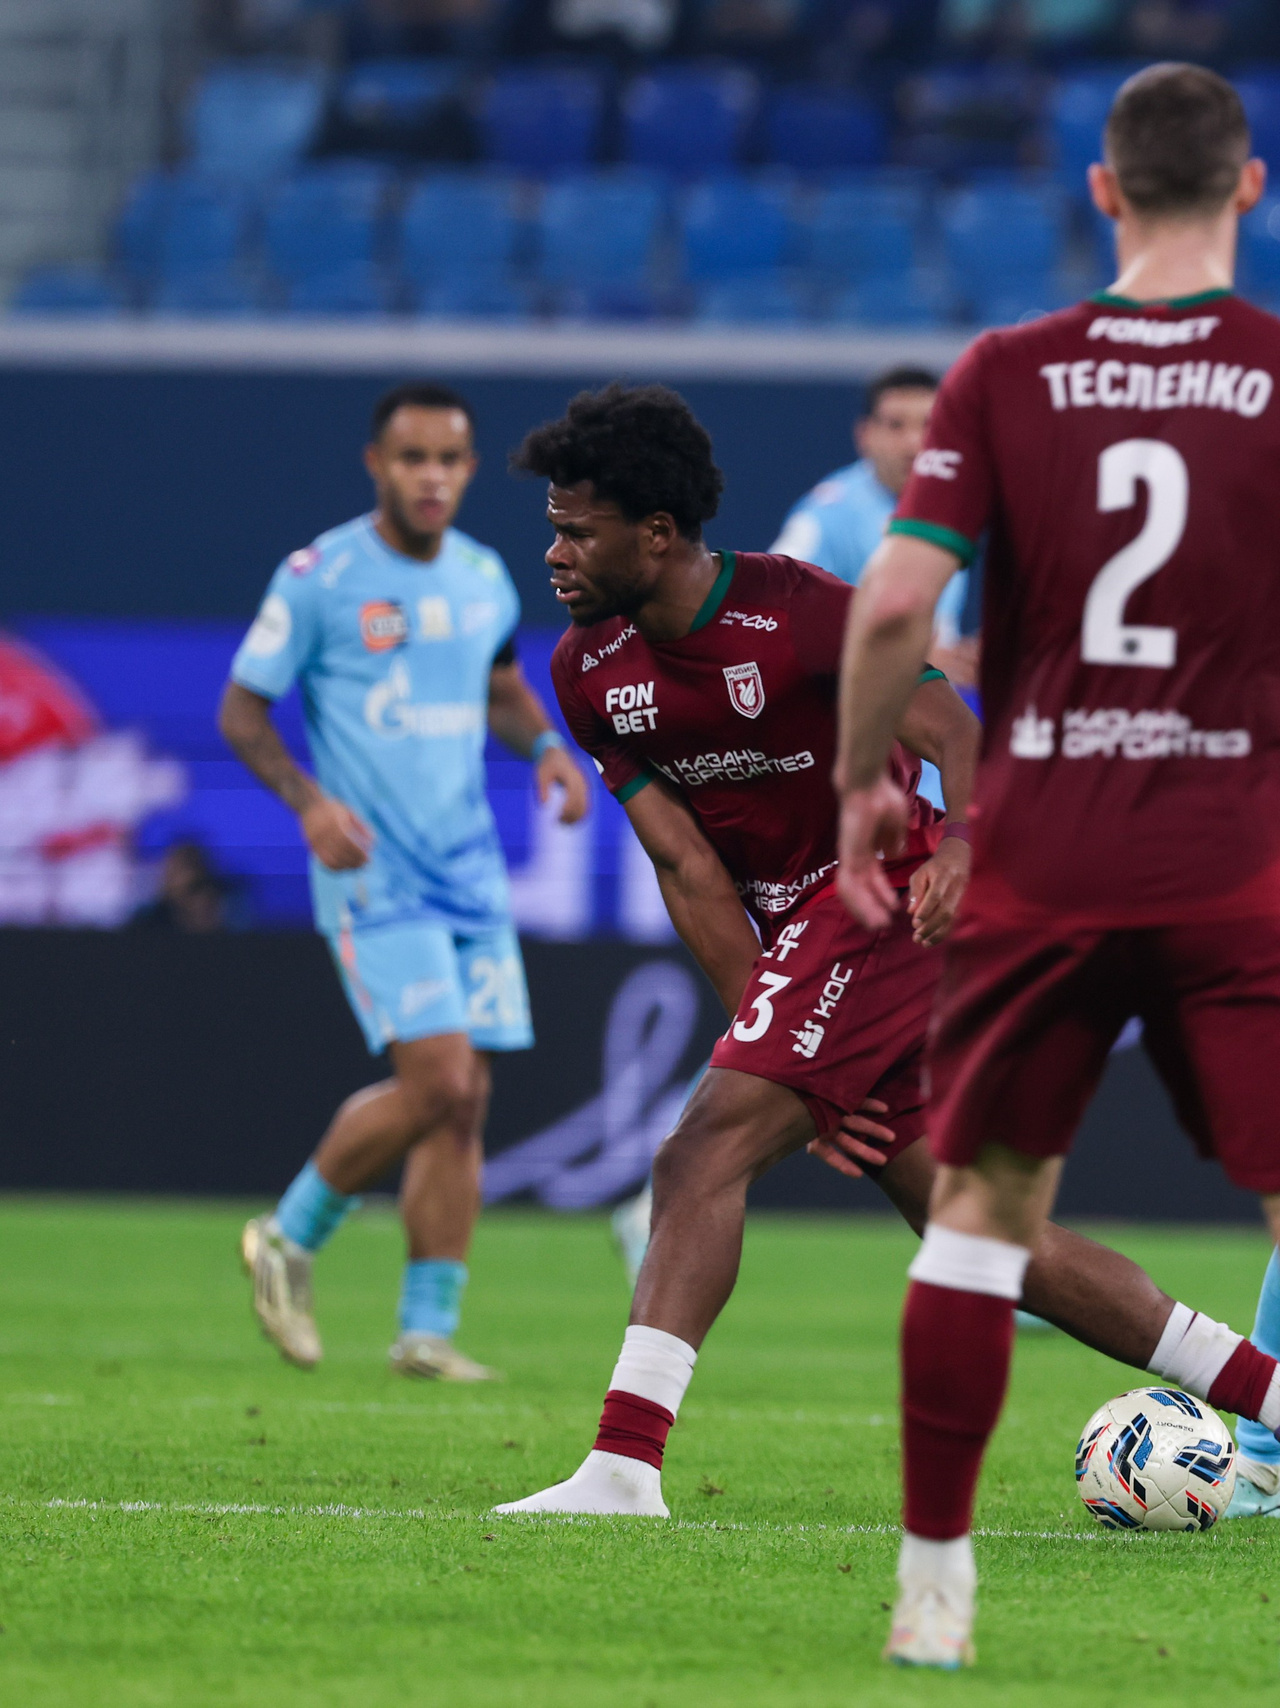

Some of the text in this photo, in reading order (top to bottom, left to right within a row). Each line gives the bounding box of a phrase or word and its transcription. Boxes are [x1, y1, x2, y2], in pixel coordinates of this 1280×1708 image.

[1086, 315, 1221, 348] FONBET
[1040, 359, 1273, 418] ТЕСЛЕНКО
[1080, 437, 1189, 669] 2
[598, 623, 637, 659] НКНХ
[605, 681, 655, 713] FON
[612, 706, 659, 735] BET
[674, 748, 767, 774] КАЗАНЬ
[684, 750, 816, 786] ОРГСИНТЕЗ
[812, 961, 854, 1019] КОС
